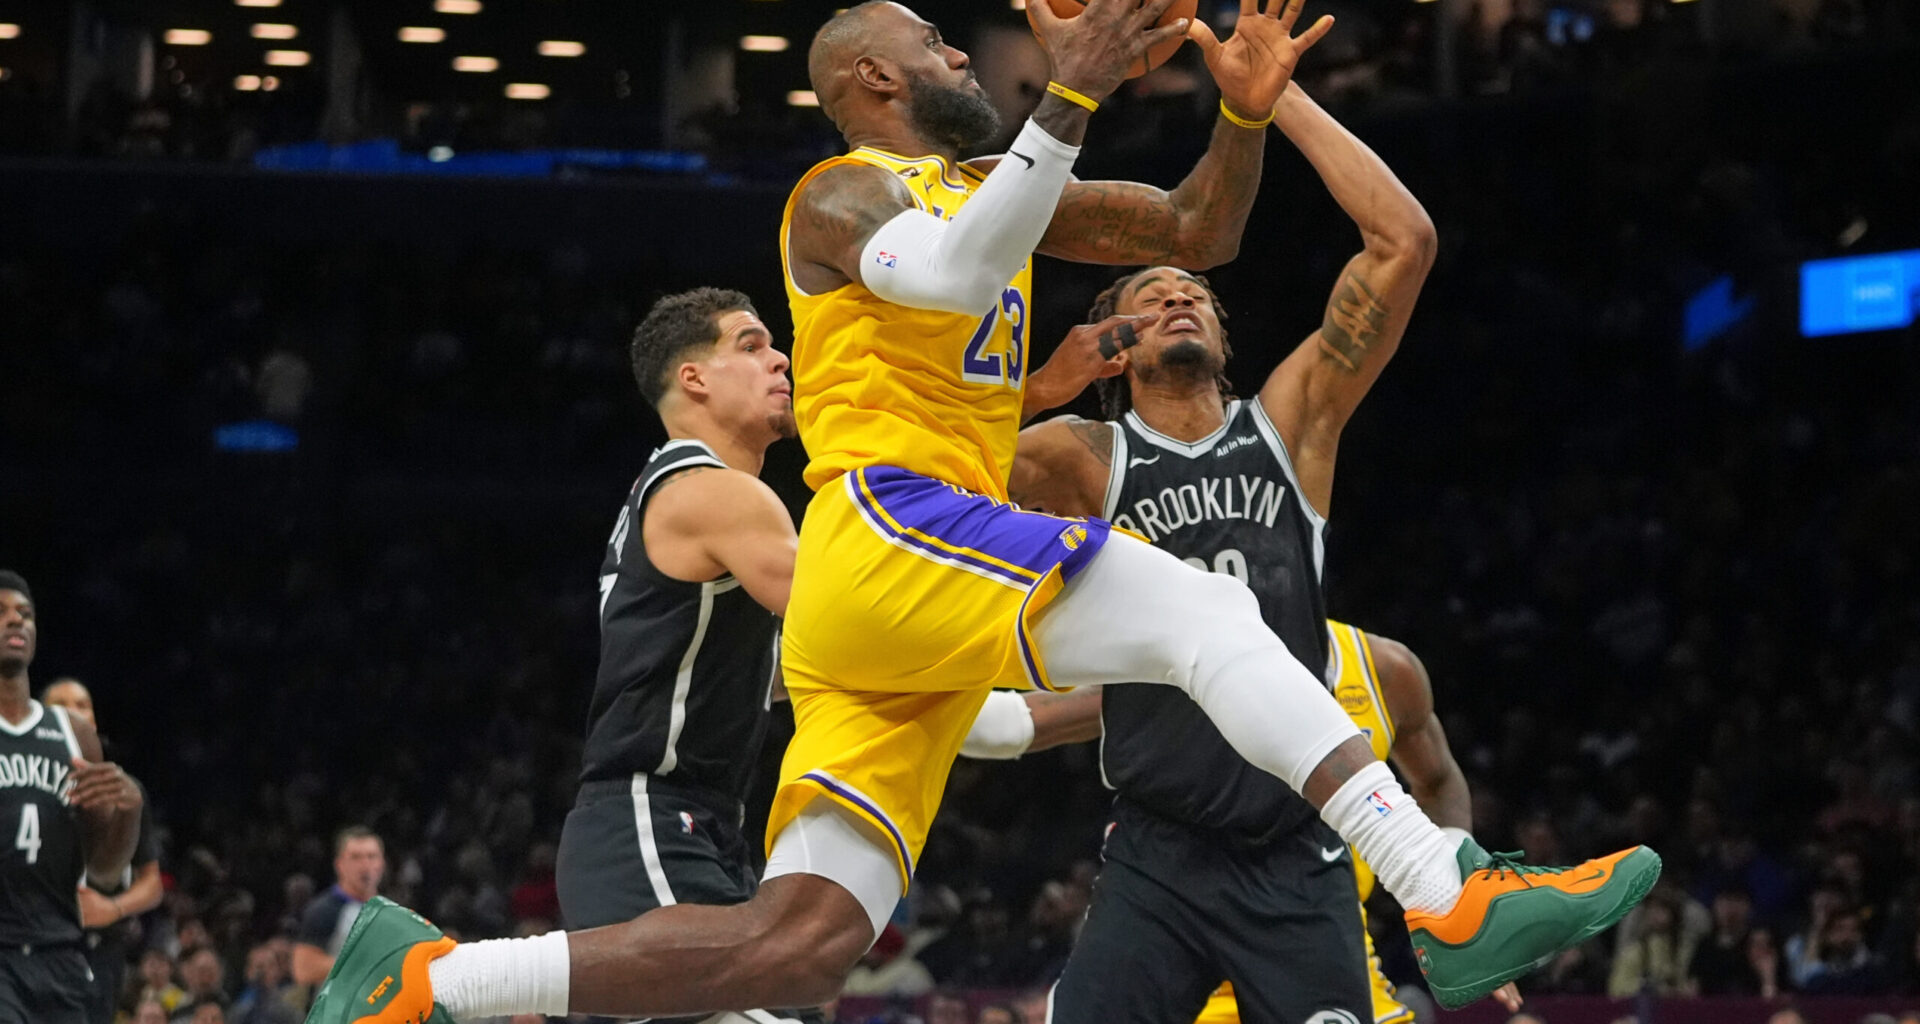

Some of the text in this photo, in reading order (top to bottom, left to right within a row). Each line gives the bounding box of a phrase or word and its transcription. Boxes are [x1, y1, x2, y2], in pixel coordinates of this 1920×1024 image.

[963, 285, 1026, 393] 23
[1216, 444, 1230, 458] All
[15, 803, 42, 864] 4
